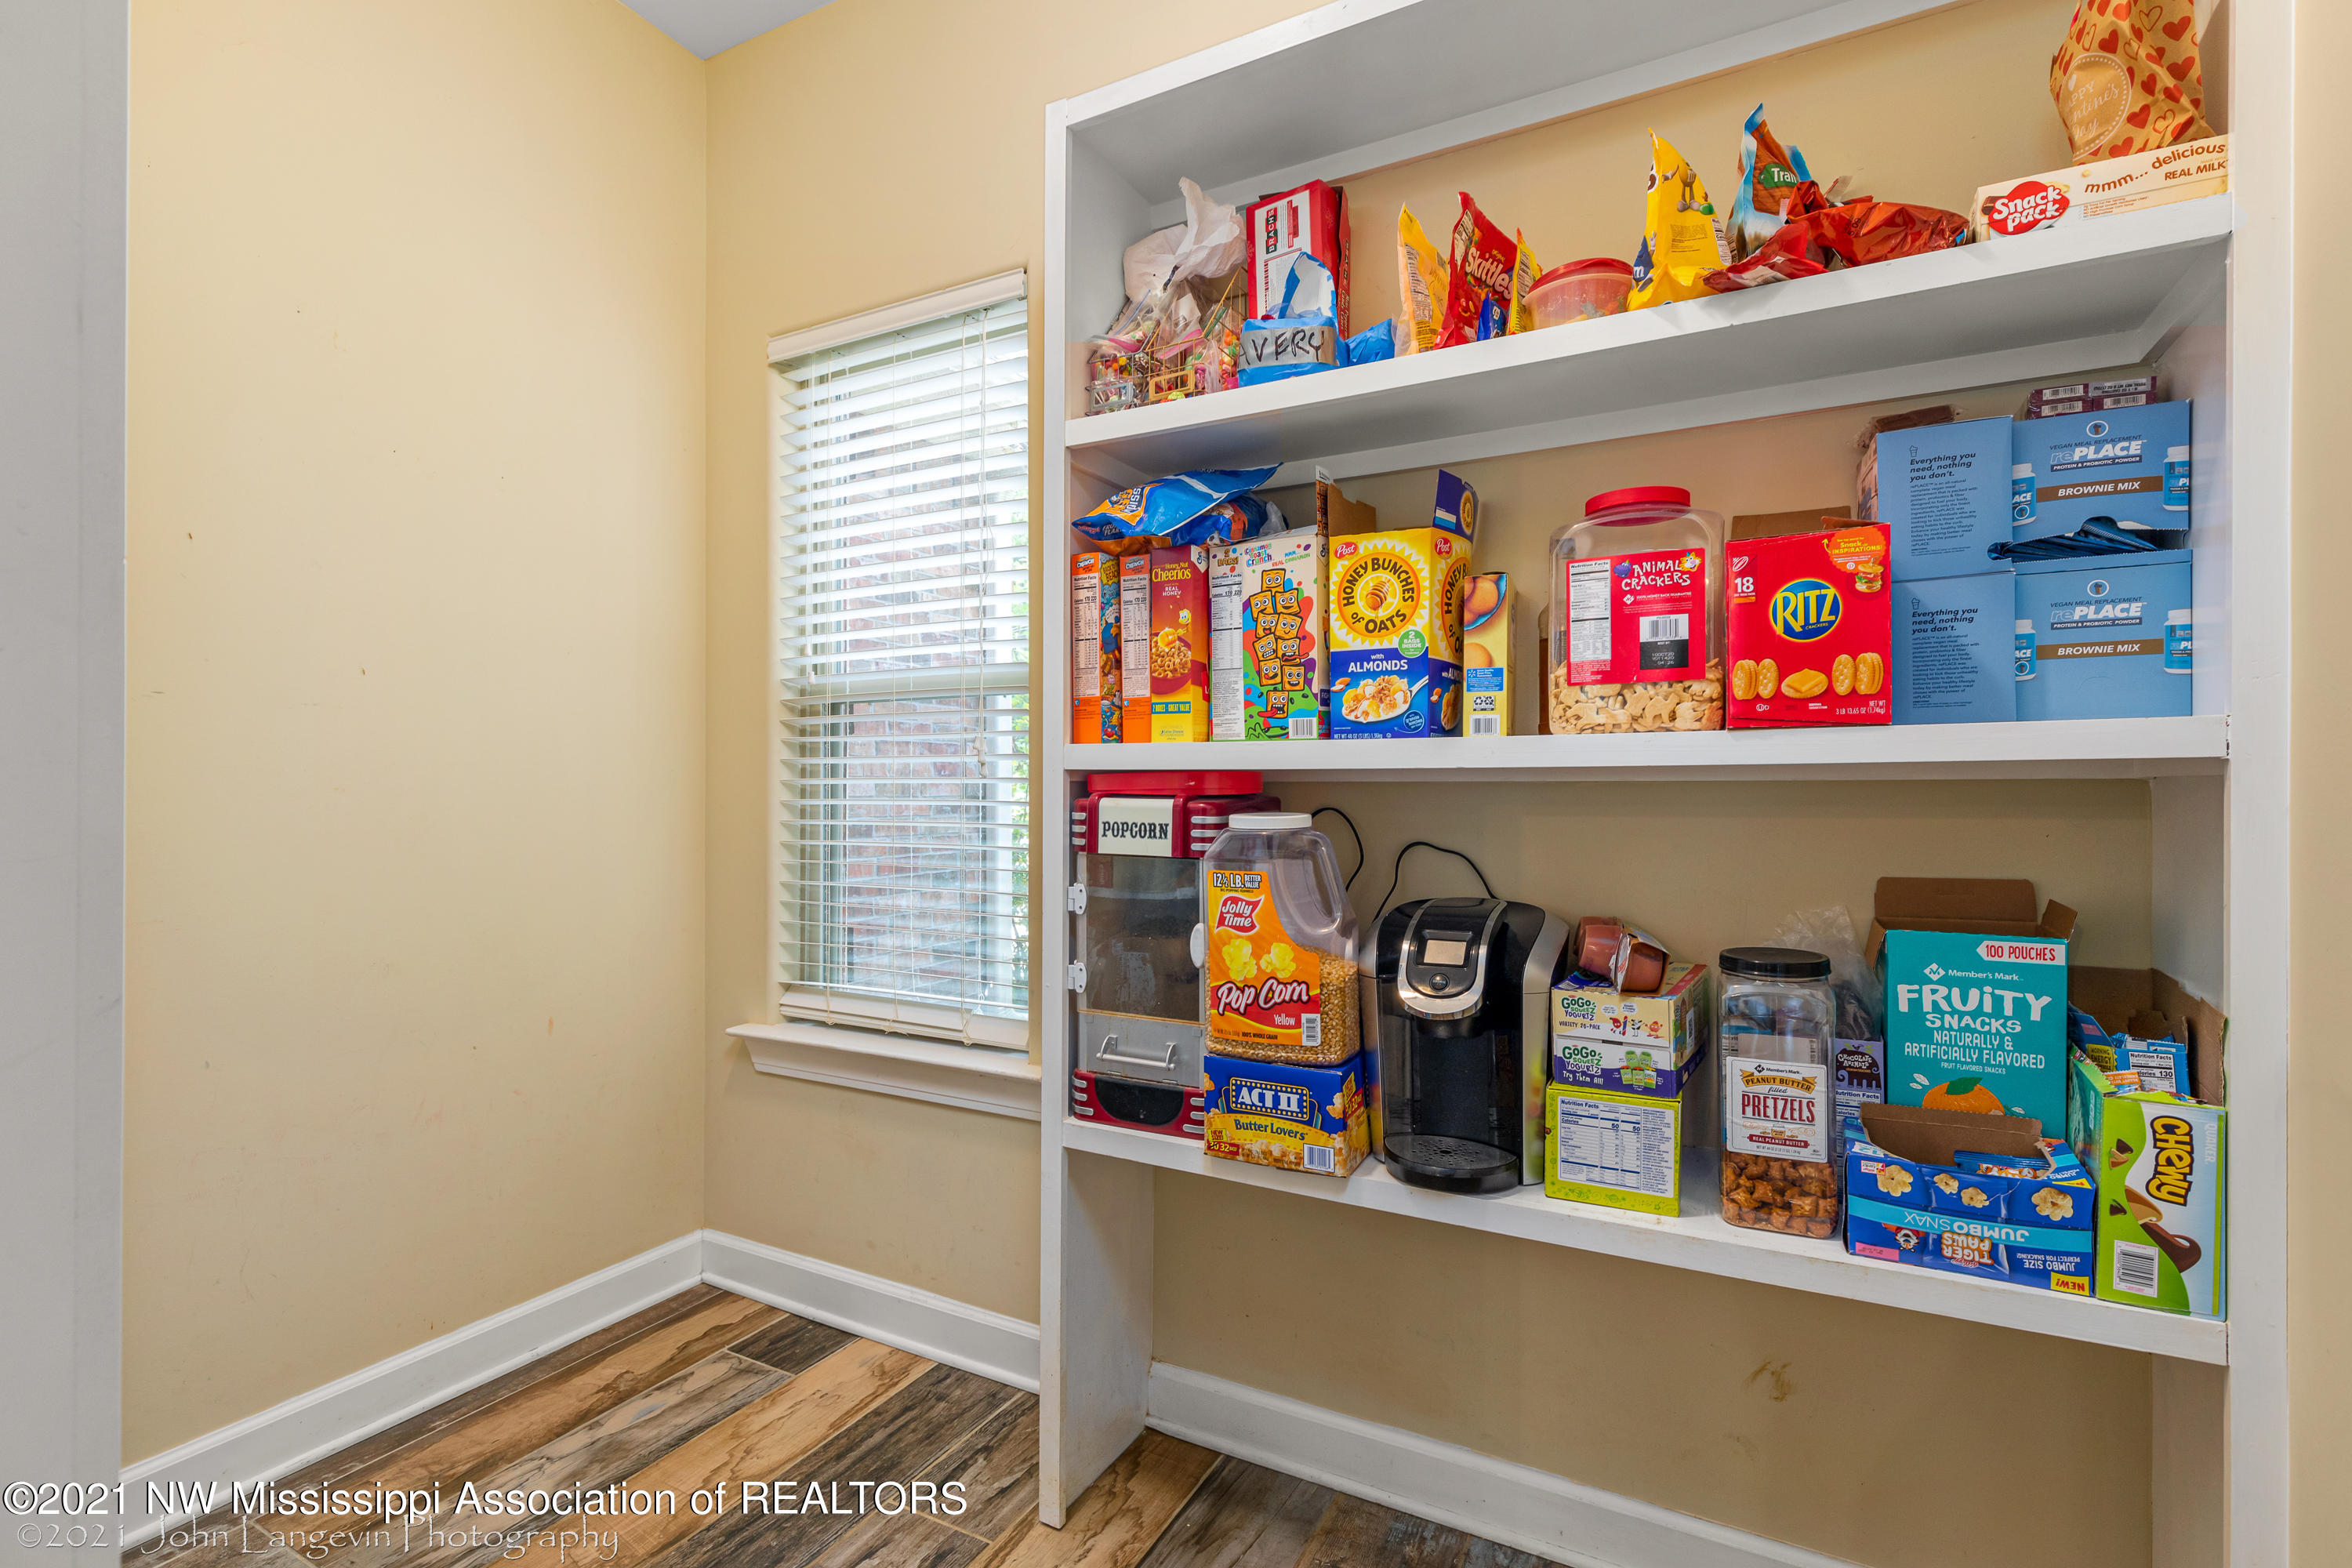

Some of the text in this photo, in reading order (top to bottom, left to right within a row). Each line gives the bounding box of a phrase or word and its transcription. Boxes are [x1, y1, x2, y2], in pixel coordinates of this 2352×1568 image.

[2151, 142, 2227, 170] delicious
[2165, 168, 2193, 181] REAL
[1992, 187, 2063, 220] Snack
[1465, 247, 1515, 300] Skittles
[1238, 328, 1325, 368] AVERY
[2094, 434, 2142, 445] REPLACEMENT
[2050, 440, 2143, 464] rePLACE
[1911, 453, 1976, 466] Everything you
[1936, 461, 1973, 470] nothing
[1929, 470, 1955, 480] don't.
[2057, 481, 2142, 497] BROWNIE MIX
[1244, 543, 1272, 554] Cinnamon
[1337, 543, 1356, 557] Post
[1436, 538, 1450, 555] Post
[1832, 545, 1882, 554] INSPIRATIONS!
[1218, 556, 1240, 567] BAGS!
[1247, 554, 1272, 568] Crunch
[1284, 553, 1311, 564] CINNAMON
[1152, 568, 1192, 583] Cheerios
[1342, 557, 1415, 608] HONEY BUNCHES
[1621, 572, 1691, 591] CRACKERS
[1734, 576, 1755, 593] 18
[2094, 596, 2142, 605] REPLACEMENT
[1776, 588, 1836, 635] RITZ
[1912, 608, 1959, 618] Everything
[2050, 601, 2143, 622] rePLACE
[1364, 608, 1407, 634] OATS
[2057, 643, 2141, 655] BROWNIE MIX
[1348, 659, 1408, 673] ALMONDS
[1102, 821, 1170, 840] POPCORN
[1229, 873, 1244, 887] LB.
[1243, 874, 1261, 883] BETTER
[1222, 901, 1253, 916] Jolly
[1223, 914, 1252, 927] Time
[1985, 944, 2056, 962] 100 POUCHES
[1948, 969, 2019, 981] Member's Mark
[1218, 978, 1309, 1014] Pop Corn
[1561, 996, 1592, 1010] GoGo
[1274, 1013, 1295, 1025] Yellow
[1564, 1009, 1595, 1022] YOGURTZ
[1925, 1013, 2022, 1034] SNACKS
[1933, 1029, 2014, 1051] NATURALLY &
[1562, 1046, 1597, 1060] GoGo
[1904, 1042, 2045, 1069] ARTIFICIALLY FLAVORED
[2090, 1054, 2111, 1065] ENERGY
[1566, 1061, 1601, 1075] YOGURTZ
[1573, 1057, 1602, 1067] SQUEEZ
[1957, 1063, 1983, 1073] FLAVORED
[1984, 1065, 2006, 1074] SNACKS
[1563, 1070, 1591, 1083] Try Them
[1745, 1076, 1811, 1092] PEANUT BUTTER
[1767, 1086, 1788, 1094] filled
[1238, 1087, 1301, 1112] ACT II
[1741, 1093, 1816, 1123] PRETZELS
[1234, 1119, 1305, 1142] Butter Lovers
[1220, 1142, 1230, 1152] 32
[1904, 1210, 2030, 1242] JUMBO SNAX
[1942, 1232, 1990, 1250] PAWS
[1942, 1243, 1993, 1264] TIGER
[2023, 1259, 2075, 1272] JUMBO SIZE
[2055, 1277, 2085, 1293] NEW!
